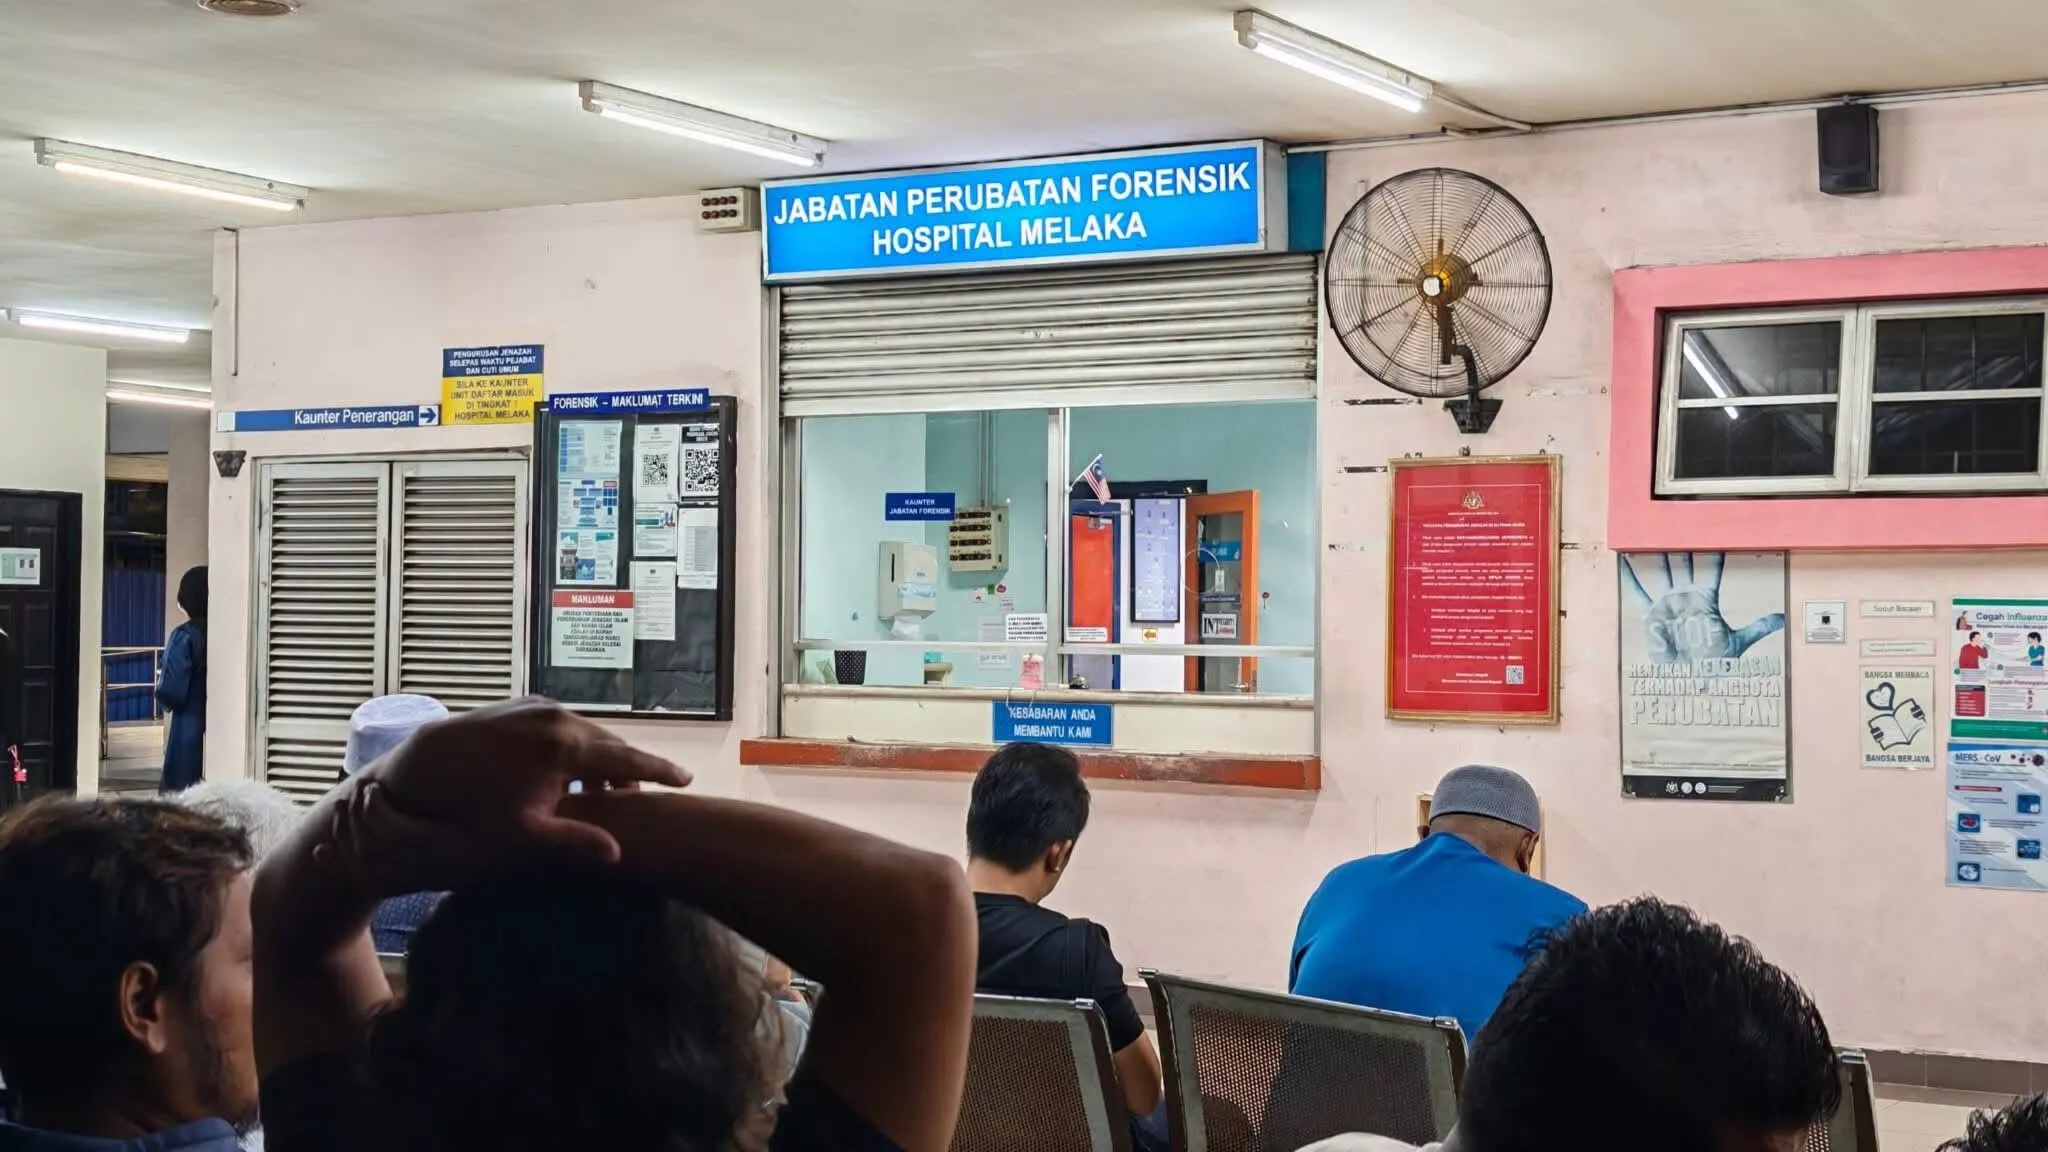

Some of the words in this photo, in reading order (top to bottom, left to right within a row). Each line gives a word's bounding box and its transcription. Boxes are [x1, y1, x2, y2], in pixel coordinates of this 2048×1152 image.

[774, 190, 898, 226] JABATAN
[907, 175, 1082, 217] PERUBATAN
[1091, 161, 1251, 201] FORENSIK
[873, 220, 1012, 256] HOSPITAL
[1020, 211, 1147, 246] MELAKA
[453, 349, 499, 358] PENGURUSAN
[500, 348, 532, 356] JENAZAH
[449, 359, 479, 367] SELEPAS
[480, 358, 505, 366] WAKTU
[505, 356, 536, 364] PEJABAT
[456, 380, 474, 388] SILA
[489, 378, 528, 387] KAUNTER
[450, 391, 469, 399] UNIT
[471, 390, 503, 398] DAFTAR
[505, 388, 535, 397] MASUK
[466, 401, 474, 409] DI
[477, 400, 512, 408] TINGKAT
[554, 396, 598, 409] FORENSIK
[611, 394, 662, 408] MAKLUMAT
[667, 393, 703, 406] TERKINI
[295, 410, 340, 424] Kaunter
[342, 408, 414, 425] Penerangan
[455, 411, 493, 420] HOSPITAL
[496, 410, 530, 418] MELAKA
[571, 594, 615, 604] MAKLUMAN
[1976, 612, 2005, 622] Cegah
[1630, 663, 1691, 678] HENTIKAN
[1864, 671, 1893, 679] BANGSA
[1895, 671, 1929, 679] MEMBACA
[1631, 678, 1705, 696] TERHADAP
[1708, 678, 1781, 697] ANGGOTA
[1009, 707, 1066, 720] KESABARAN
[1071, 708, 1096, 720] ANDA
[1631, 698, 1780, 727] PERUBATAN
[1013, 724, 1065, 737] MEMBANTU
[1068, 726, 1092, 738] KAMI
[1865, 754, 1896, 762] BANGSA
[1897, 755, 1930, 763] BERJAYA
[1955, 753, 1978, 762] MERS
